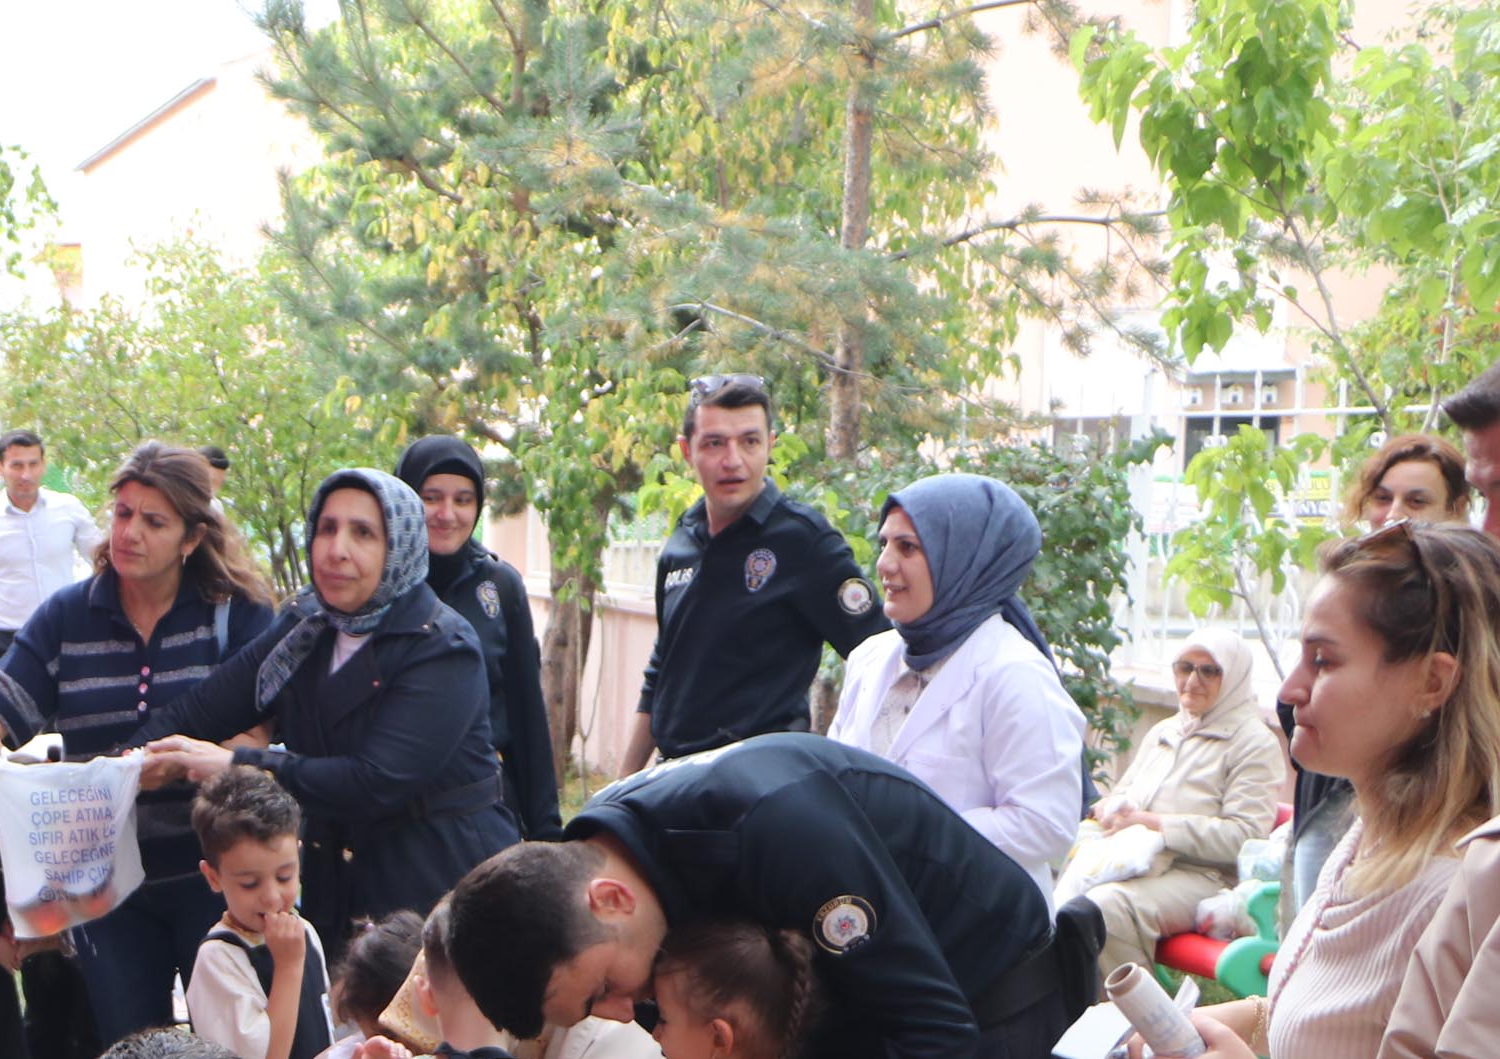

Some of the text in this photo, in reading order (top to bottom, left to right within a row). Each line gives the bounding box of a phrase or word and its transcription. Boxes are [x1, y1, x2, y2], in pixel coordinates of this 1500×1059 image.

[75, 806, 115, 824] ATMA
[28, 830, 65, 846] SIFIR
[68, 827, 100, 844] ATIK
